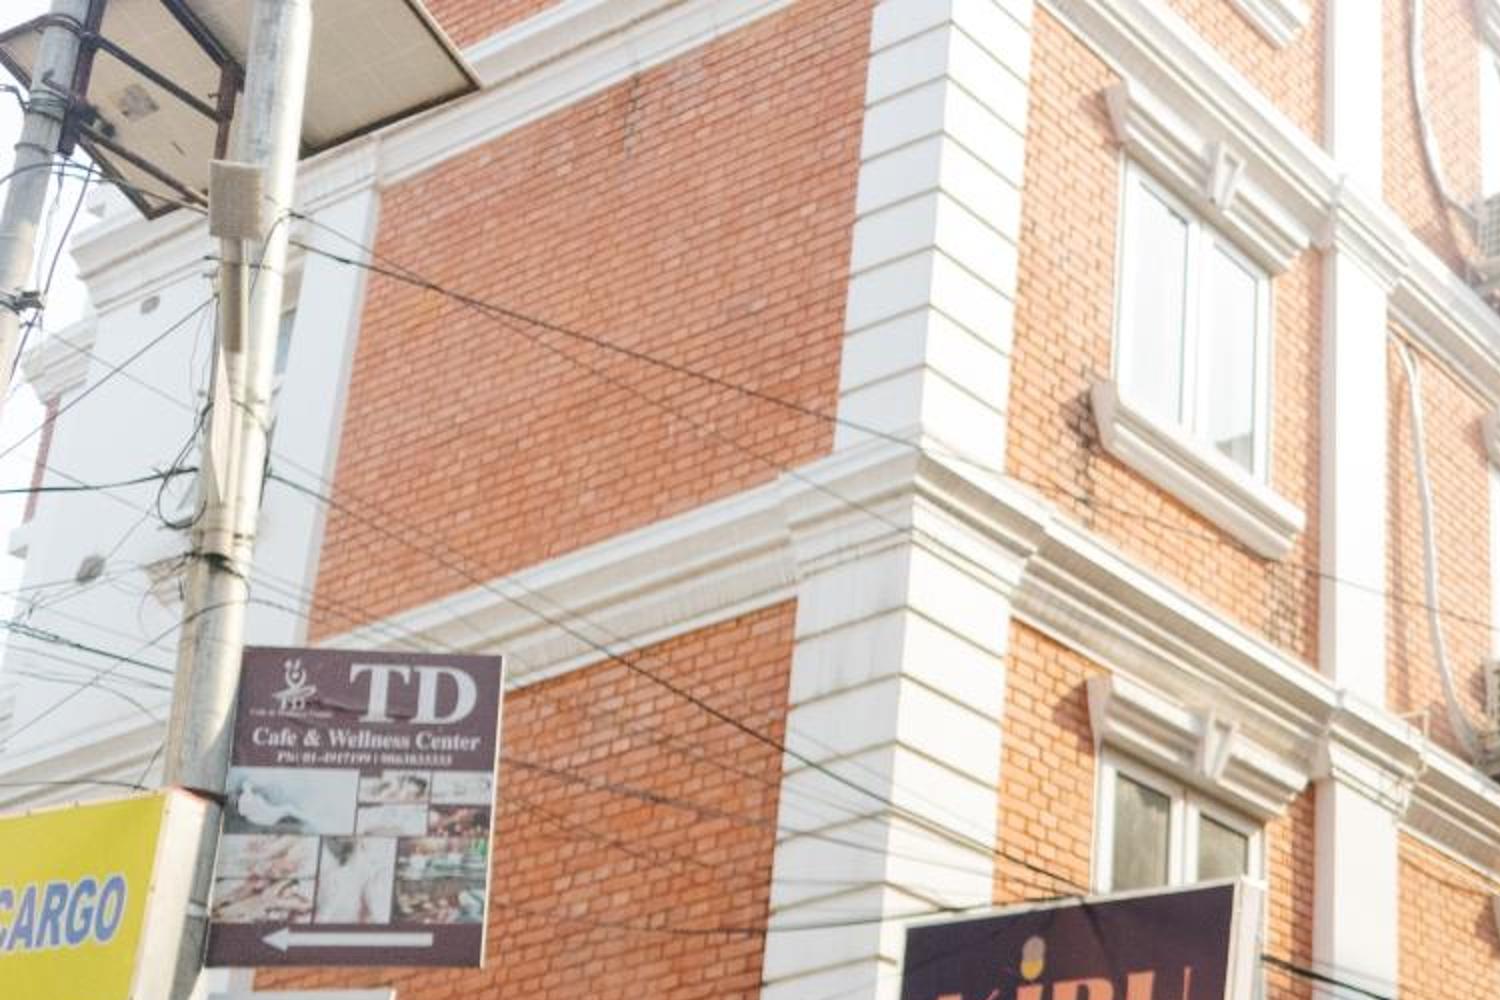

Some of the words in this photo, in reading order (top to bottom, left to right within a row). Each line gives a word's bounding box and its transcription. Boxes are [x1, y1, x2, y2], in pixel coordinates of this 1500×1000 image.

[350, 663, 478, 725] TD
[252, 727, 297, 747] Cafe
[303, 729, 321, 747] &
[329, 729, 410, 750] Wellness
[416, 731, 481, 751] Center
